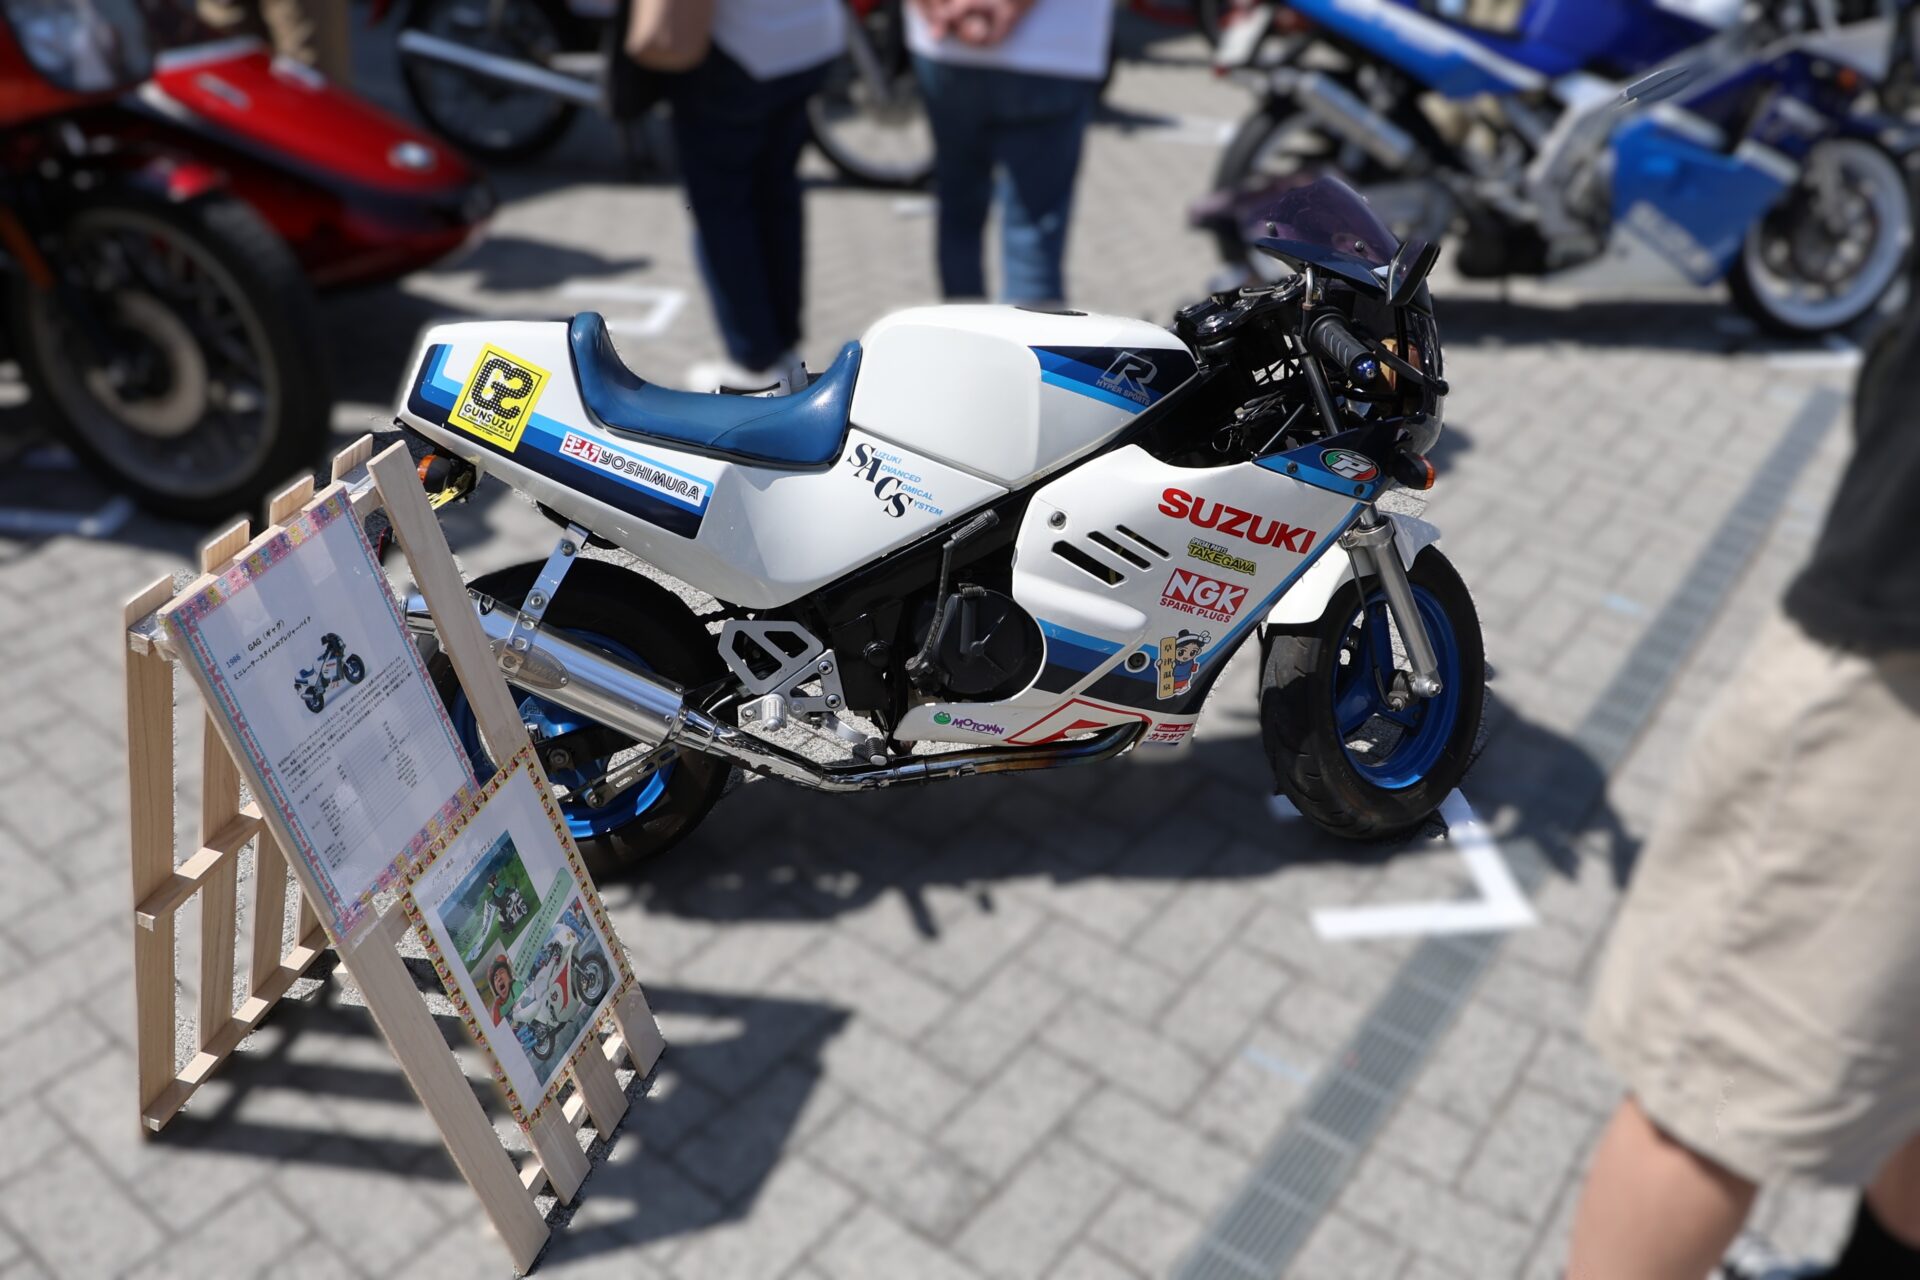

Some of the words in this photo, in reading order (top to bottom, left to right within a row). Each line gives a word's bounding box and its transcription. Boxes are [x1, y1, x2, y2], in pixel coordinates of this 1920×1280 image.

[1096, 379, 1122, 393] HYPER
[1123, 389, 1151, 406] SPORTS
[464, 403, 514, 433] GUNSUZU
[564, 434, 601, 462] ヨシムラ
[600, 450, 699, 501] YOSHIMURA
[1158, 488, 1317, 554] SUZUKI
[1188, 544, 1256, 574] TAKEGAWA
[1164, 569, 1245, 614] NGK
[1160, 598, 1195, 614] SPARK
[1196, 607, 1231, 623] PLUGS
[951, 718, 1005, 735] MOTOWN
